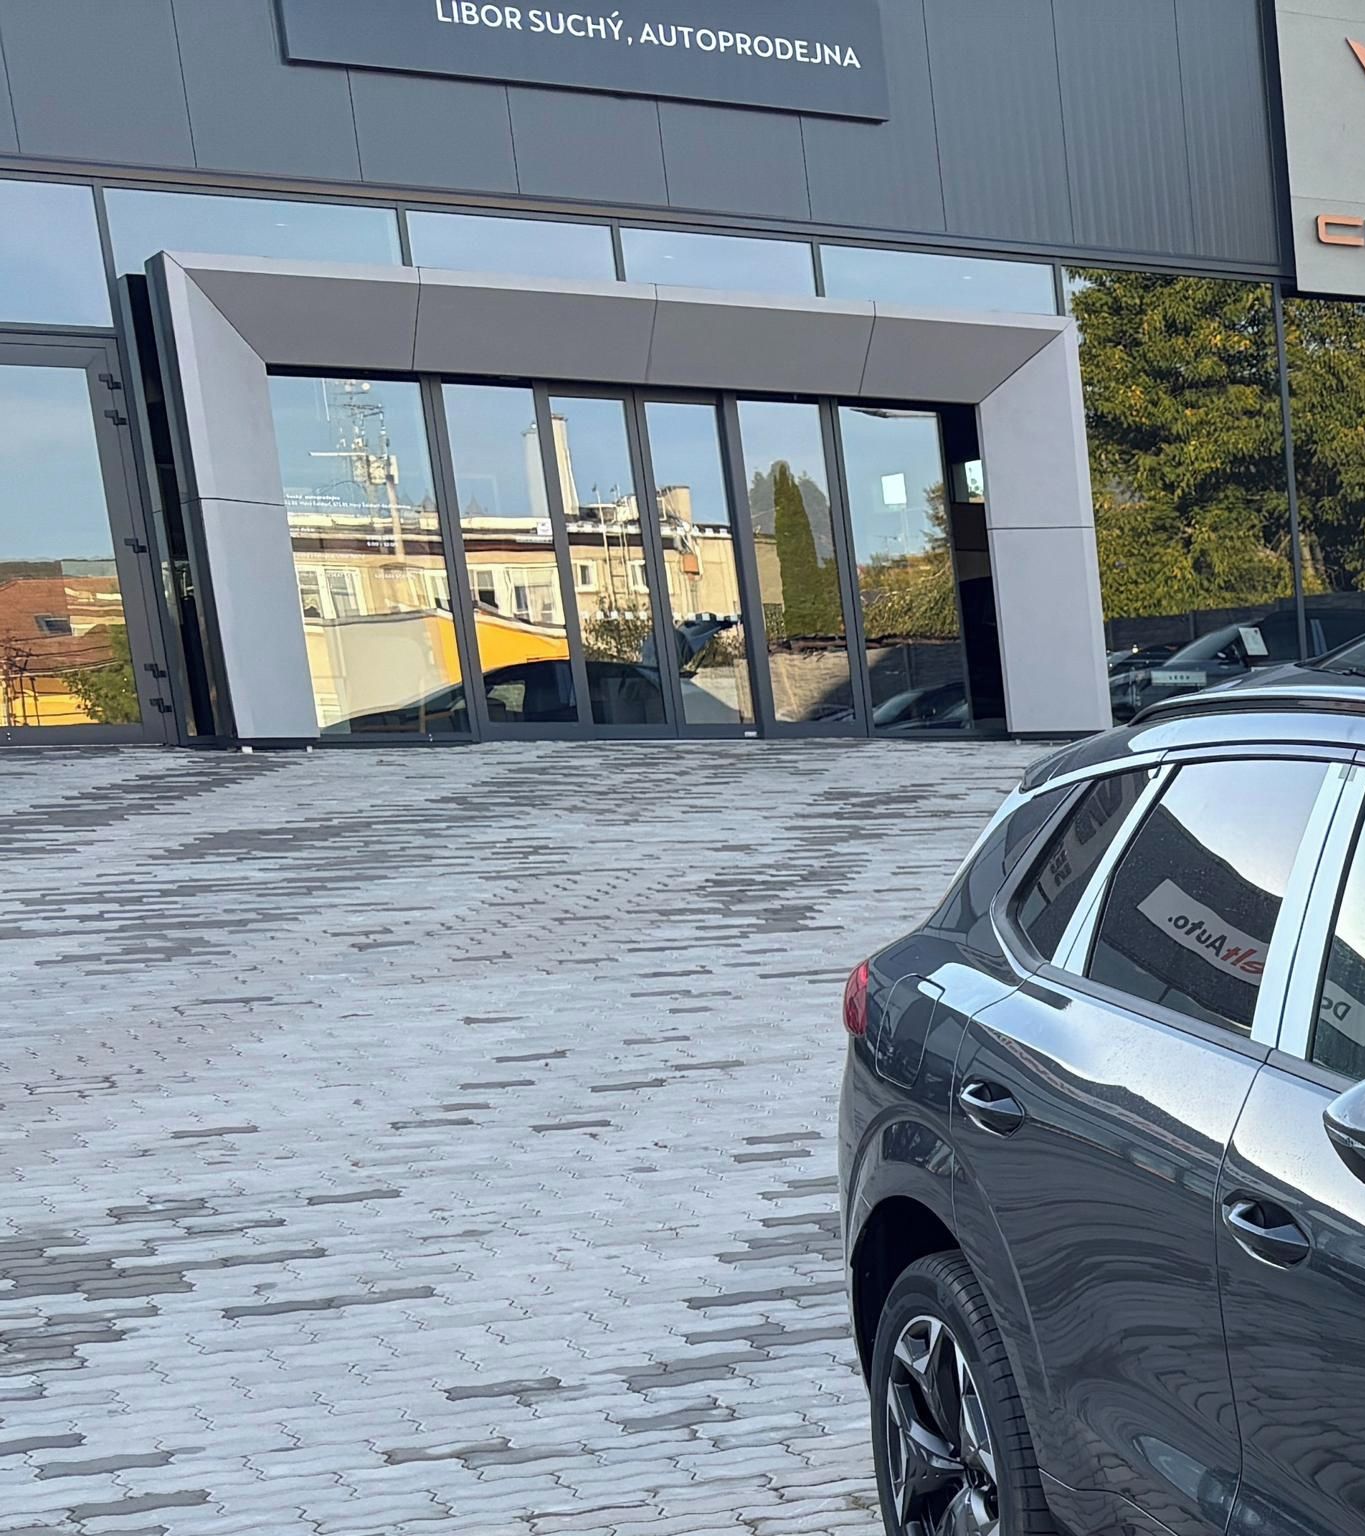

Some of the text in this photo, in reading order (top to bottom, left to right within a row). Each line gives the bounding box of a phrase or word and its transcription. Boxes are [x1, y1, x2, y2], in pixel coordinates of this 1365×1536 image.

[436, 0, 862, 69] LIBOR SUCHÝ, AUTOPRODEJNA
